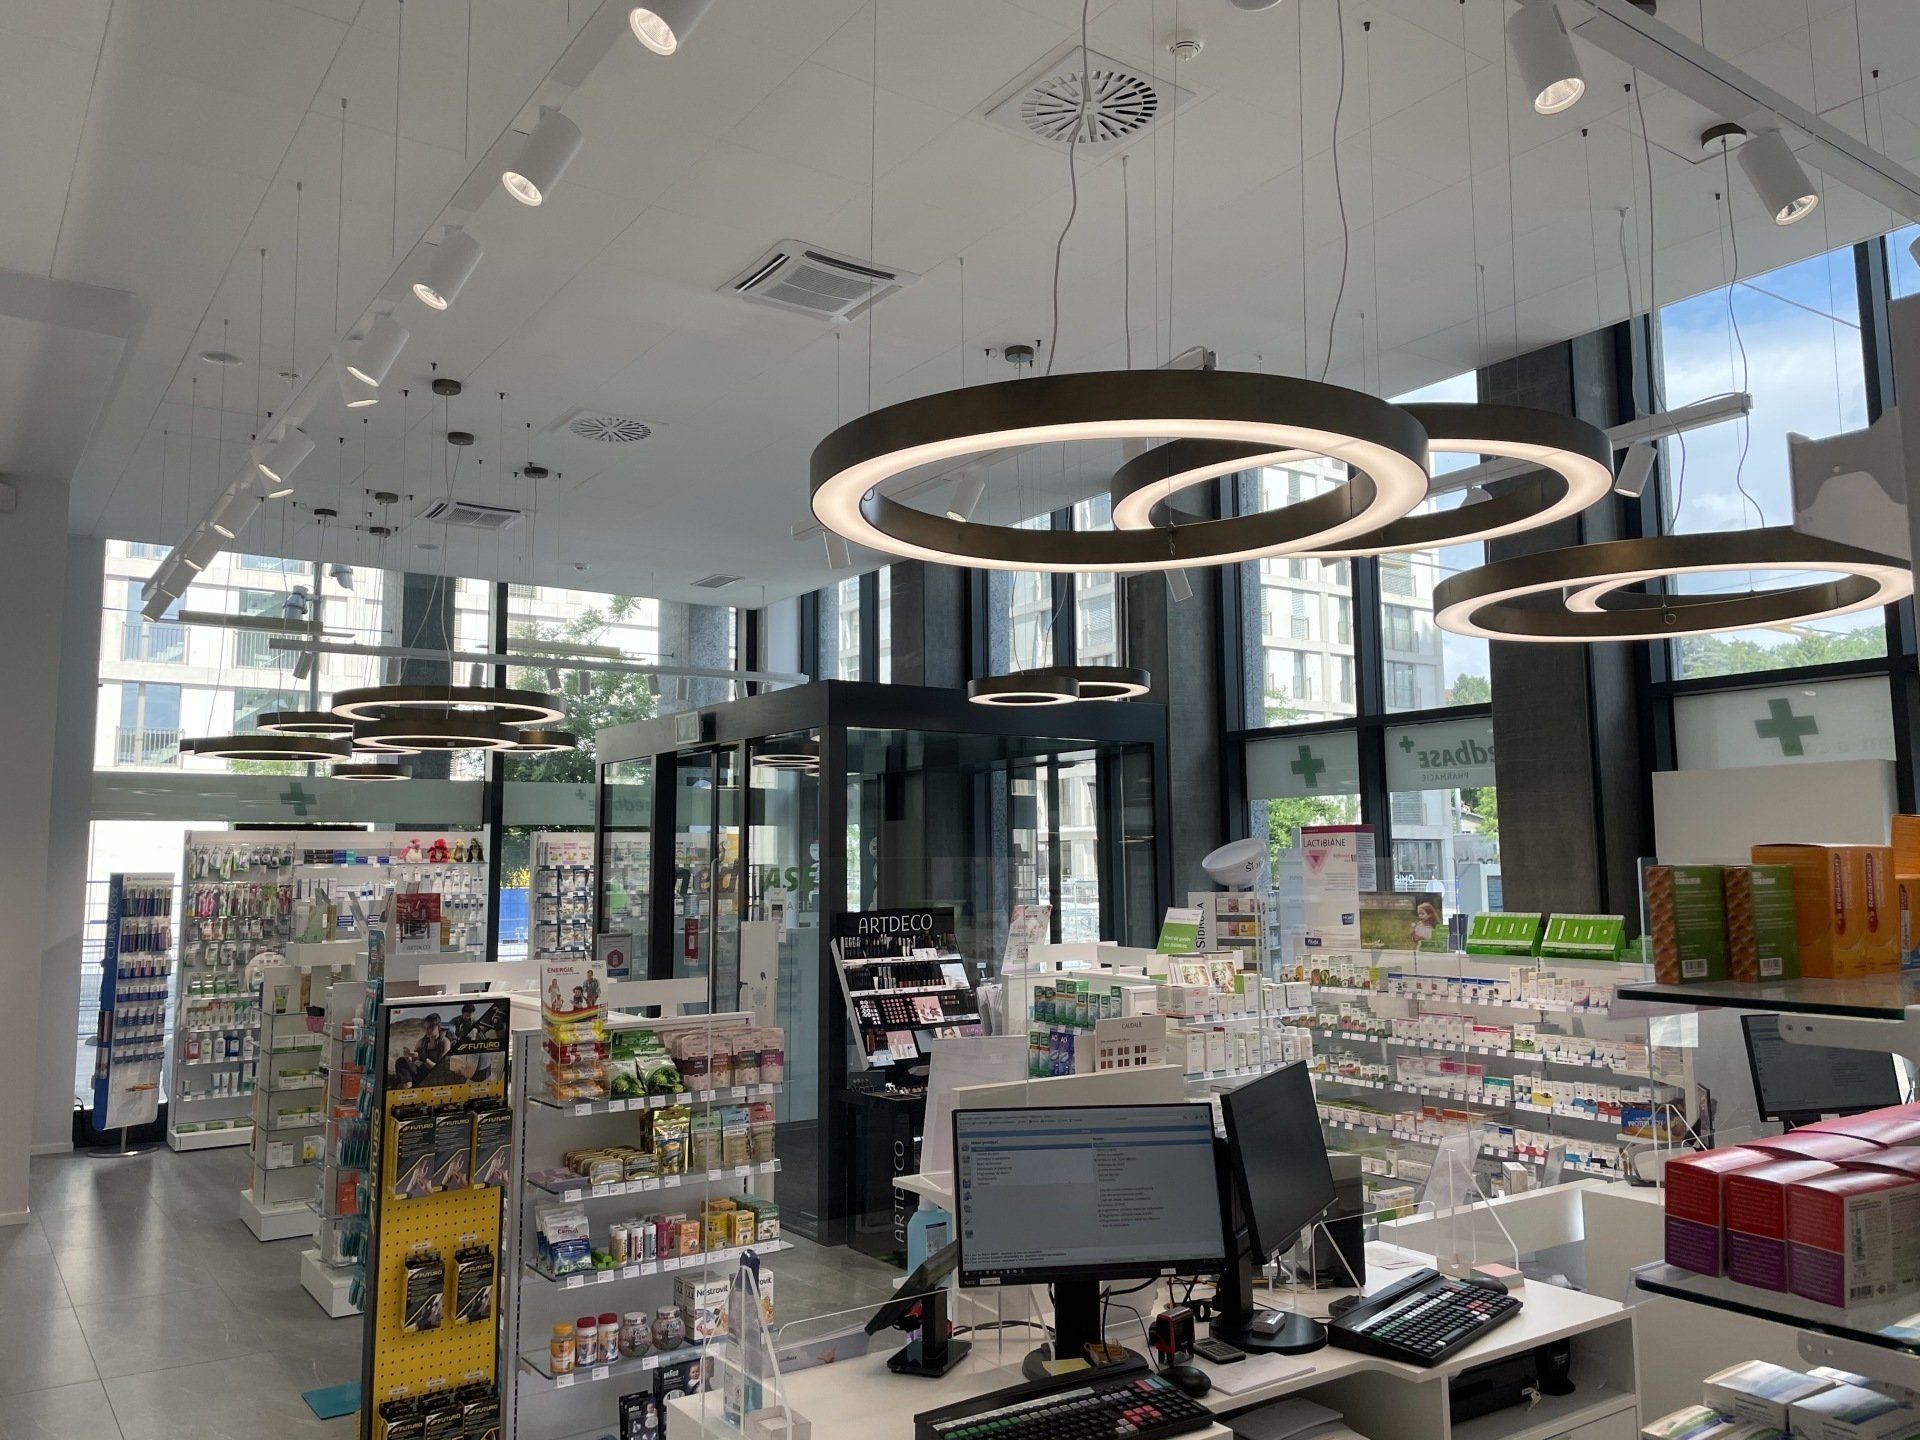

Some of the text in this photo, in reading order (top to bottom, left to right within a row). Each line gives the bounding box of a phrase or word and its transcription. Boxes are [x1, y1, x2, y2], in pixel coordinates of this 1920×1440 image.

[1834, 858, 1843, 910] Redoxon
[1866, 857, 1874, 908] Redoxon
[107, 886, 120, 960] CURAPROX
[858, 913, 933, 935] ARTDECO
[547, 966, 574, 974] ENERGIE
[468, 1041, 500, 1050] FUTURO
[487, 1115, 511, 1123] FUTURO
[410, 1123, 434, 1131] FUTURO
[371, 1108, 380, 1202] FUTURO
[893, 1140, 905, 1243] ARTDCO
[469, 1263, 492, 1272] FUTURO
[419, 1269, 443, 1279] FUTURO
[475, 1404, 499, 1414] FUTURO
[437, 1413, 462, 1423] FUTURO
[398, 1422, 423, 1432] FUTURO
